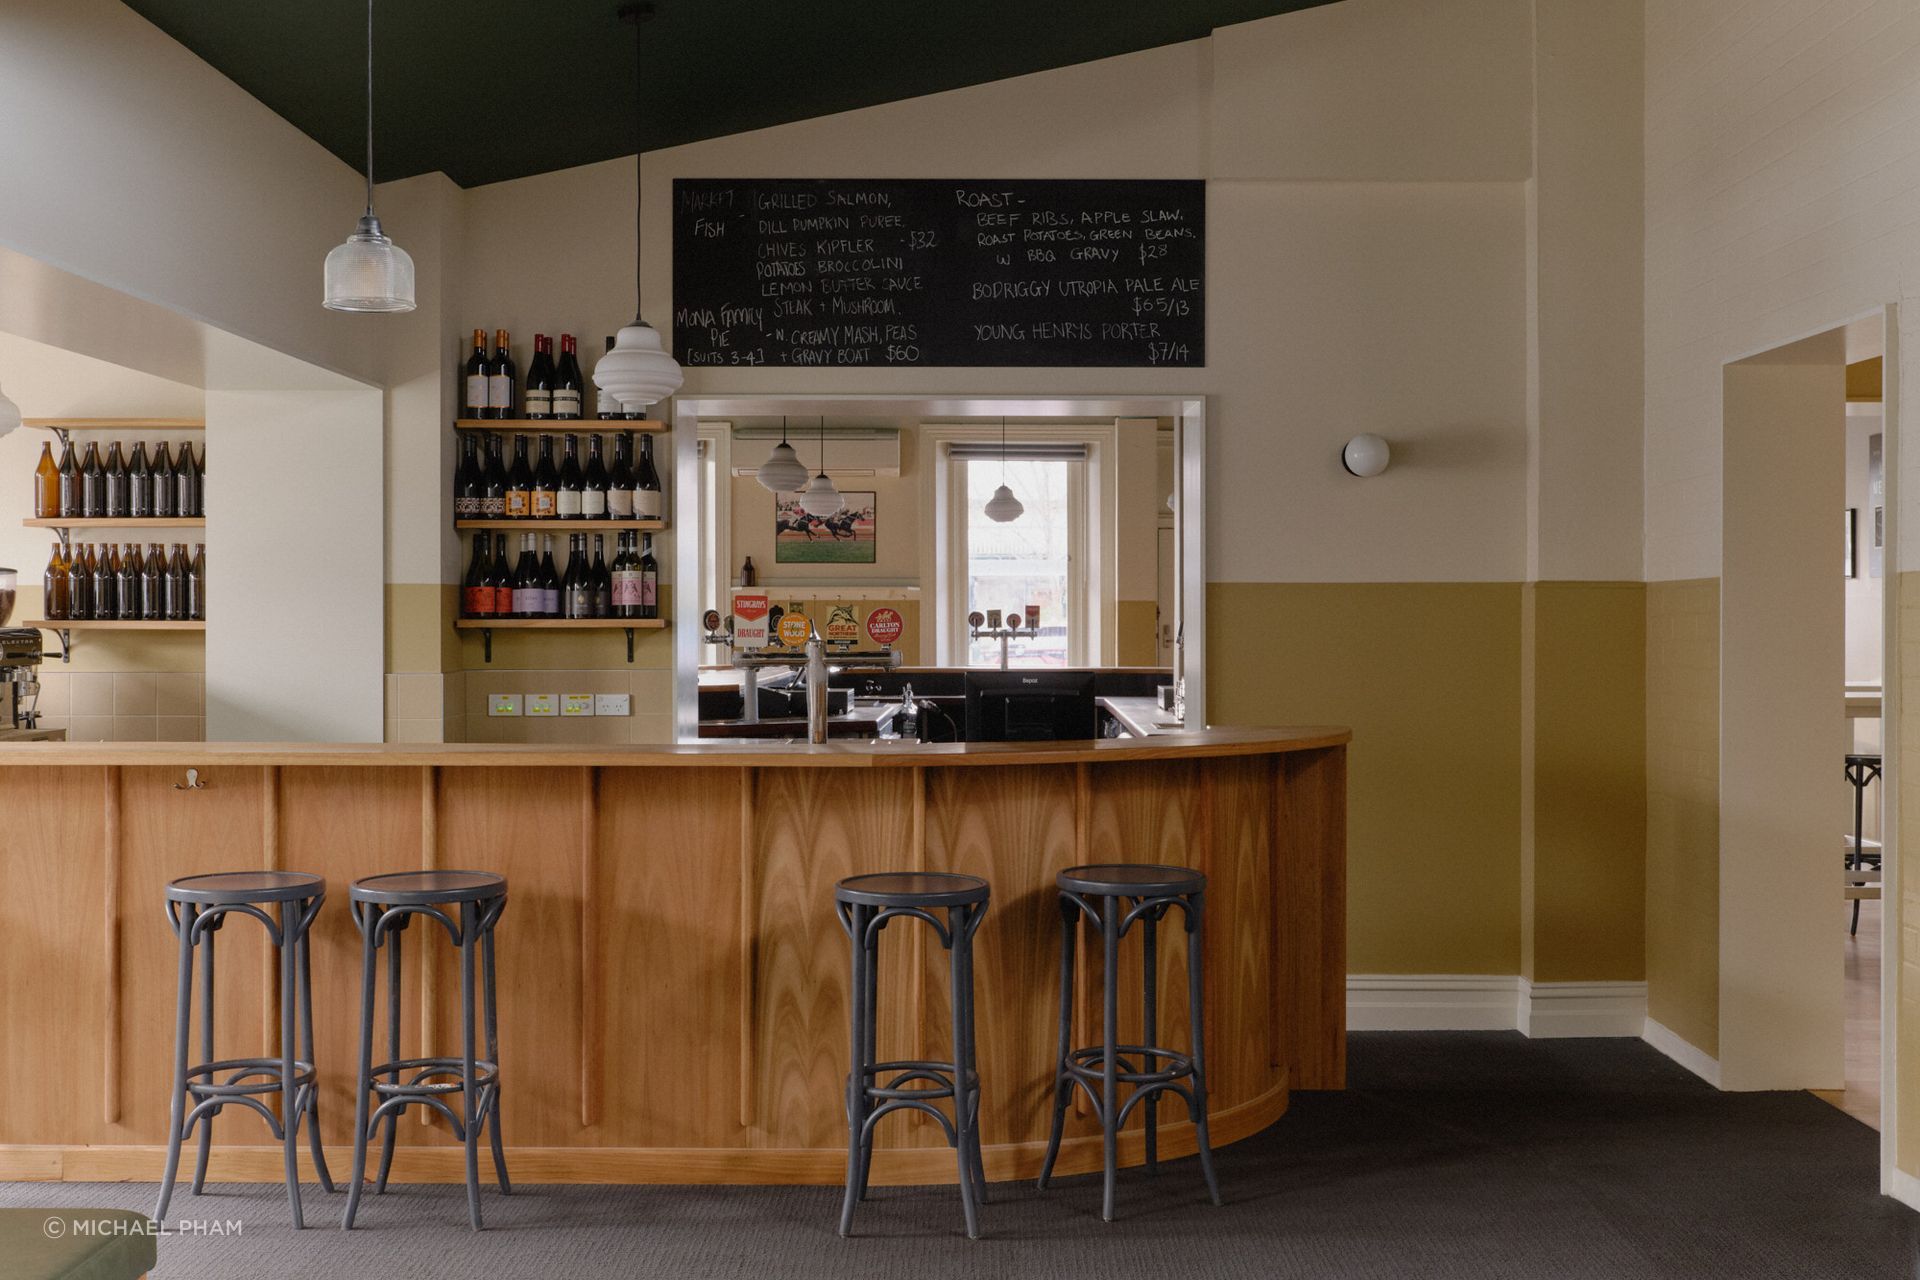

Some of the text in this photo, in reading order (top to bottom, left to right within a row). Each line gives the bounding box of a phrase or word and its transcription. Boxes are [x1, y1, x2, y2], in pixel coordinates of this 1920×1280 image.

[758, 191, 817, 210] GRILLED
[694, 218, 725, 238] FISH
[759, 220, 787, 235] DILL
[793, 216, 849, 232] PUMPKIN
[977, 212, 1021, 227] BEEF
[1081, 210, 1132, 225] APPLE
[909, 230, 937, 251] $32
[977, 232, 1016, 247] ROAST
[1089, 228, 1133, 241] GREEN
[757, 239, 874, 259] CHIVES KIPFLER
[1027, 248, 1057, 262] BBQ
[1070, 246, 1120, 263] GRAVY
[1138, 242, 1168, 266] $28
[756, 256, 903, 280] POTATOES BROCCOLINI
[761, 276, 922, 297] LEMON BUTTER SAUCE
[972, 277, 1200, 300] BODRIGGY UTROPIA PALE ALE
[676, 302, 763, 332] MONA FAMILY
[773, 298, 813, 318] STEAK
[711, 328, 730, 348] PIE
[791, 325, 839, 346] CREAMY
[885, 324, 918, 341] PEAS
[973, 321, 1161, 341] YOUNG HENRYS PORTER
[791, 348, 832, 365] GRAVY
[838, 347, 870, 364] BOAT
[885, 344, 920, 363] $60
[1147, 341, 1190, 364] $7/14
[737, 628, 765, 638] DRAUGHT
[828, 624, 857, 632] GREAT
